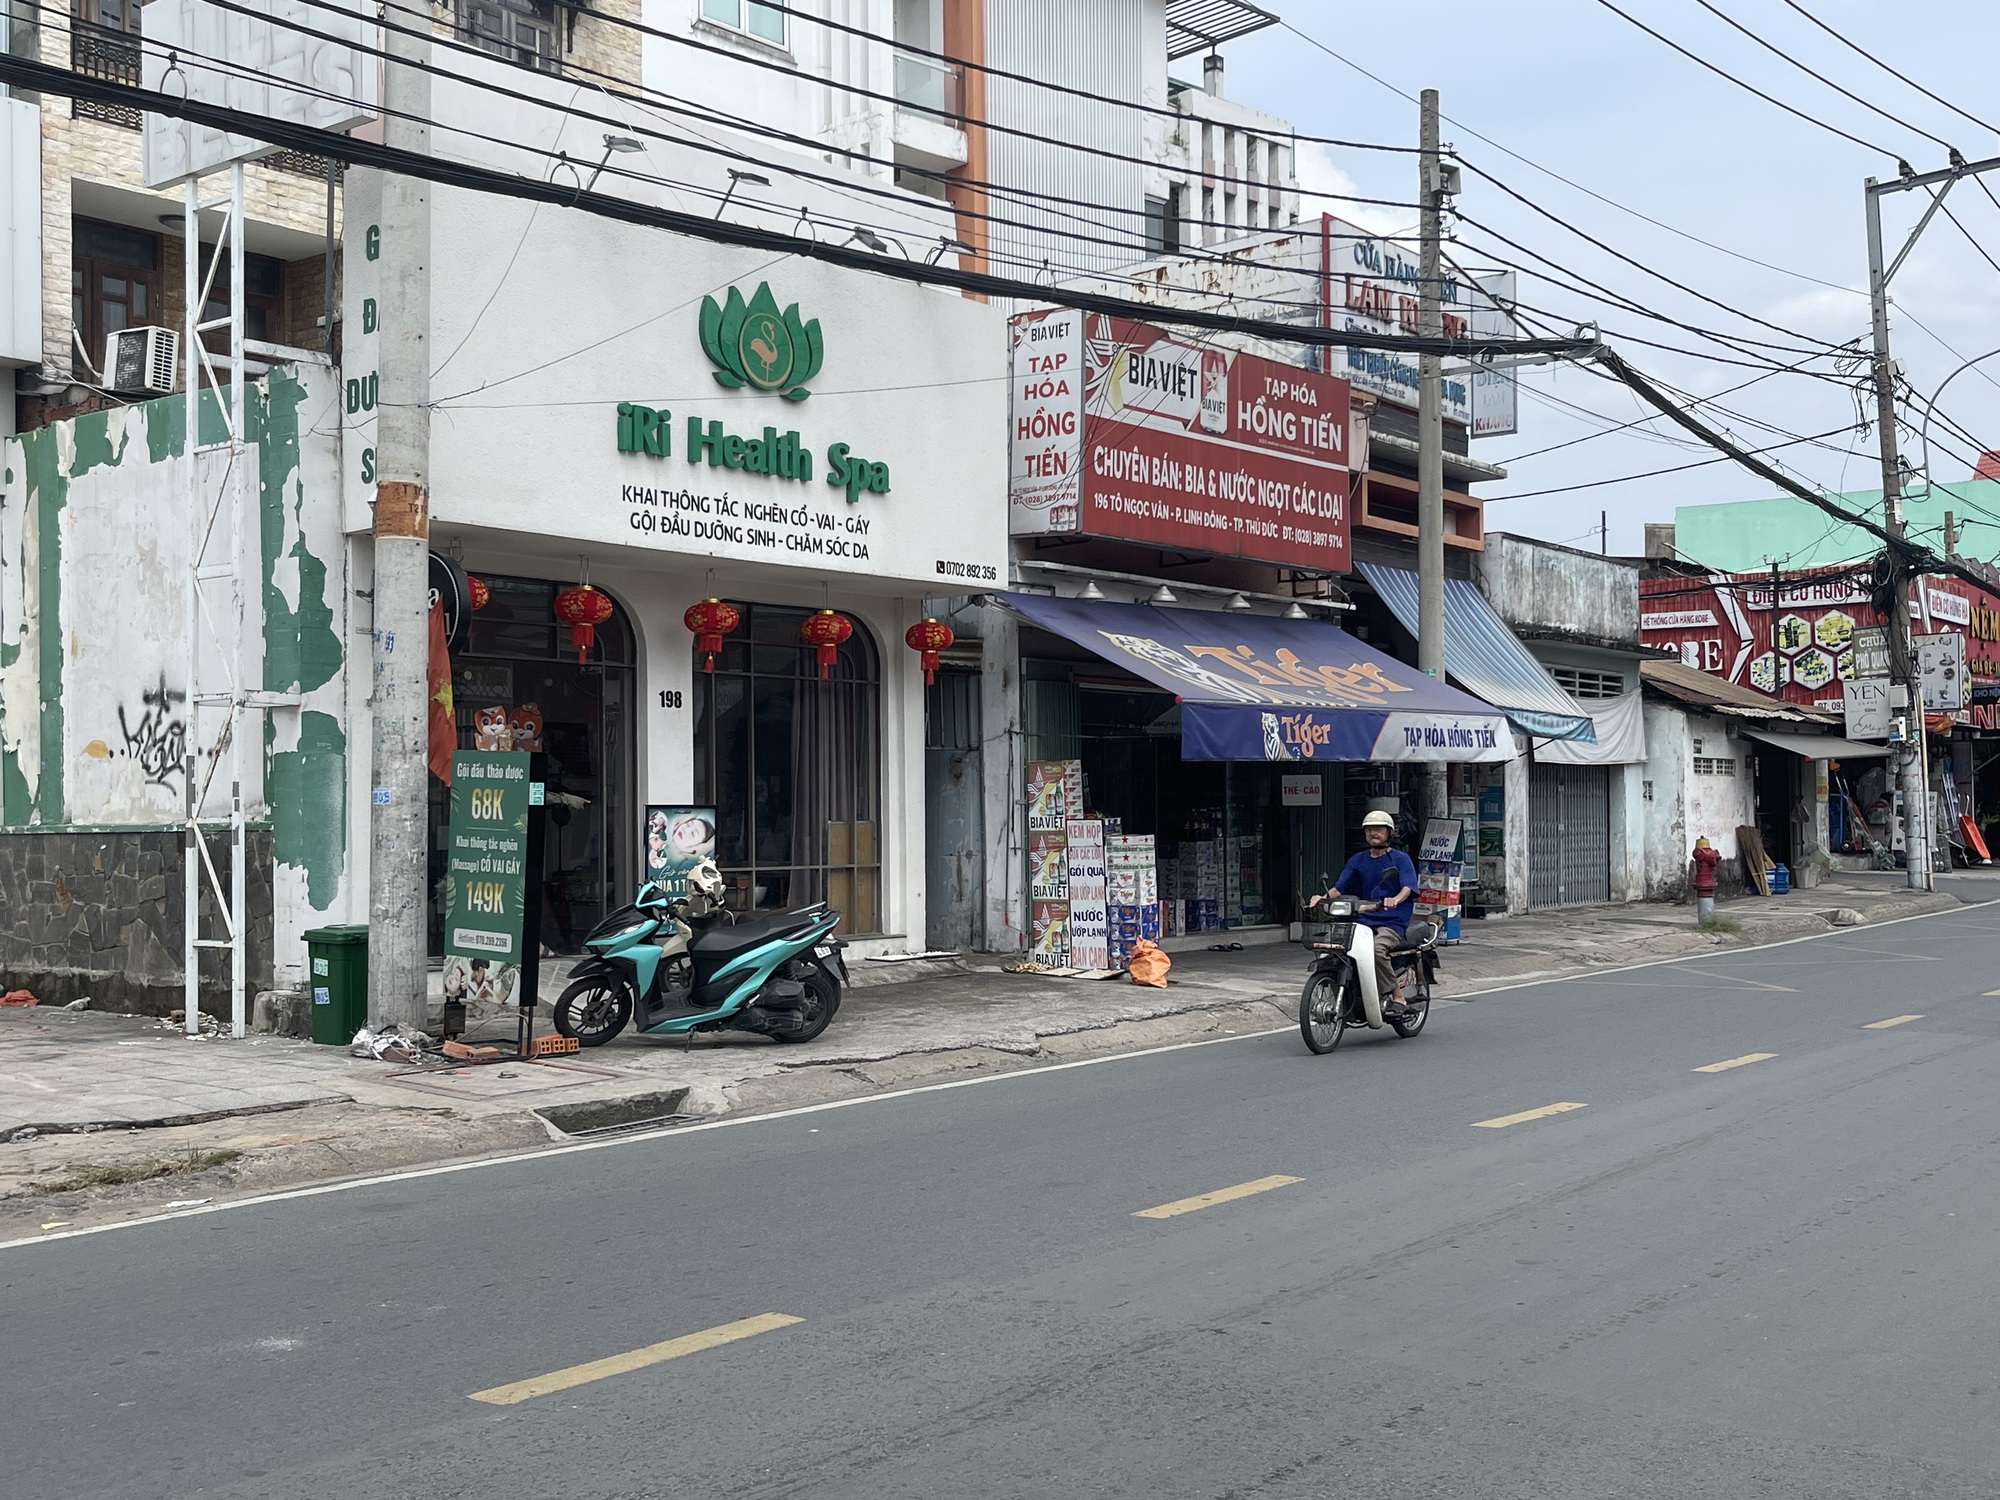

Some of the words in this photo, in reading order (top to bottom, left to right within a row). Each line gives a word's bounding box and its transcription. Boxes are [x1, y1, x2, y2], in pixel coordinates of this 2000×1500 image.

[1029, 353, 1067, 375] TẠP
[1024, 378, 1069, 400] HÓA
[1264, 376, 1288, 402] TẠP
[1290, 382, 1317, 407] HÓA
[1018, 406, 1075, 440] HỒNG
[1237, 394, 1297, 442] HỒNG
[1301, 411, 1342, 451] TIẾN
[617, 401, 672, 458] iRi
[687, 416, 813, 482] Health
[827, 441, 891, 503] Spa
[1025, 444, 1067, 478] TIẾN
[1094, 445, 1149, 484] CHUYÊN
[1152, 452, 1182, 491] BÁN:
[1185, 463, 1206, 496] BIA
[1208, 468, 1217, 498] &
[1219, 468, 1256, 505] NƯỚC
[1258, 478, 1291, 516] NGỌT
[1293, 481, 1317, 516] CÁC
[1318, 490, 1343, 525] LOẠI
[622, 483, 658, 506] KHAI
[661, 488, 711, 513] THÔNG
[713, 491, 739, 518] TẮC
[744, 501, 789, 525] NGHẼN
[790, 504, 808, 528] CỔ
[816, 512, 835, 531] VAI
[846, 513, 870, 536] GÁY
[1094, 493, 1108, 509] 196
[1110, 493, 1123, 512] TÔ
[1124, 498, 1150, 520] NGỌC
[1152, 500, 1170, 521] VÂN
[1175, 506, 1183, 523] P.
[1184, 509, 1203, 527] LINH
[1204, 509, 1228, 530] ĐÔNG
[1233, 517, 1245, 533] TP.
[1246, 516, 1261, 535] THỦ
[1262, 519, 1279, 538] ĐỨC
[1282, 525, 1294, 541] ĐT:
[1295, 529, 1312, 547] (028)
[1313, 531, 1328, 546] 3897
[1328, 533, 1343, 549] 9714
[630, 510, 657, 534] GỘI
[661, 509, 690, 537] ĐẦU
[694, 516, 743, 544] DƯỠNG
[747, 528, 776, 549] SINH
[786, 532, 823, 555] CHĂM
[826, 534, 850, 558] SÓC
[853, 539, 869, 560] DA
[946, 560, 965, 577] 0702
[967, 562, 982, 579] 892
[982, 564, 997, 580] 356
[1970, 596, 2000, 649] NỆM
[1858, 632, 1888, 648] CHÙA
[1855, 648, 1870, 670] PHỔ
[1183, 644, 1413, 705] Tiger
[659, 690, 682, 708] 198
[1849, 681, 1886, 700] YÊN
[1974, 689, 1988, 698] KHO
[1281, 712, 1331, 758] Tiger
[1403, 725, 1420, 754] TẠP
[1424, 721, 1446, 748] HÓA
[1447, 719, 1473, 748] HỒNG
[1475, 722, 1497, 749] TIẾN
[456, 762, 470, 781] Gội
[486, 762, 504, 779] thảo
[505, 764, 524, 783] được
[471, 787, 505, 821] 68K
[1068, 824, 1084, 839] KEM
[1086, 821, 1101, 840] HỘP
[1429, 835, 1450, 847] NƯỚC
[455, 835, 470, 848] Khai
[470, 835, 488, 852] thông
[451, 857, 480, 874] (Massage)
[480, 852, 491, 872] CỔ
[492, 858, 505, 873] VAI
[505, 855, 521, 875] GÁY
[1069, 863, 1085, 877] GÓI
[1087, 862, 1105, 878] QUÀ
[466, 880, 505, 914] 149K
[1074, 906, 1104, 922] NƯỚC
[1072, 925, 1087, 938] ƯỚP
[1087, 927, 1107, 941] LẠNH
[1072, 941, 1088, 967] BÁN
[1088, 946, 1108, 968] CARD
